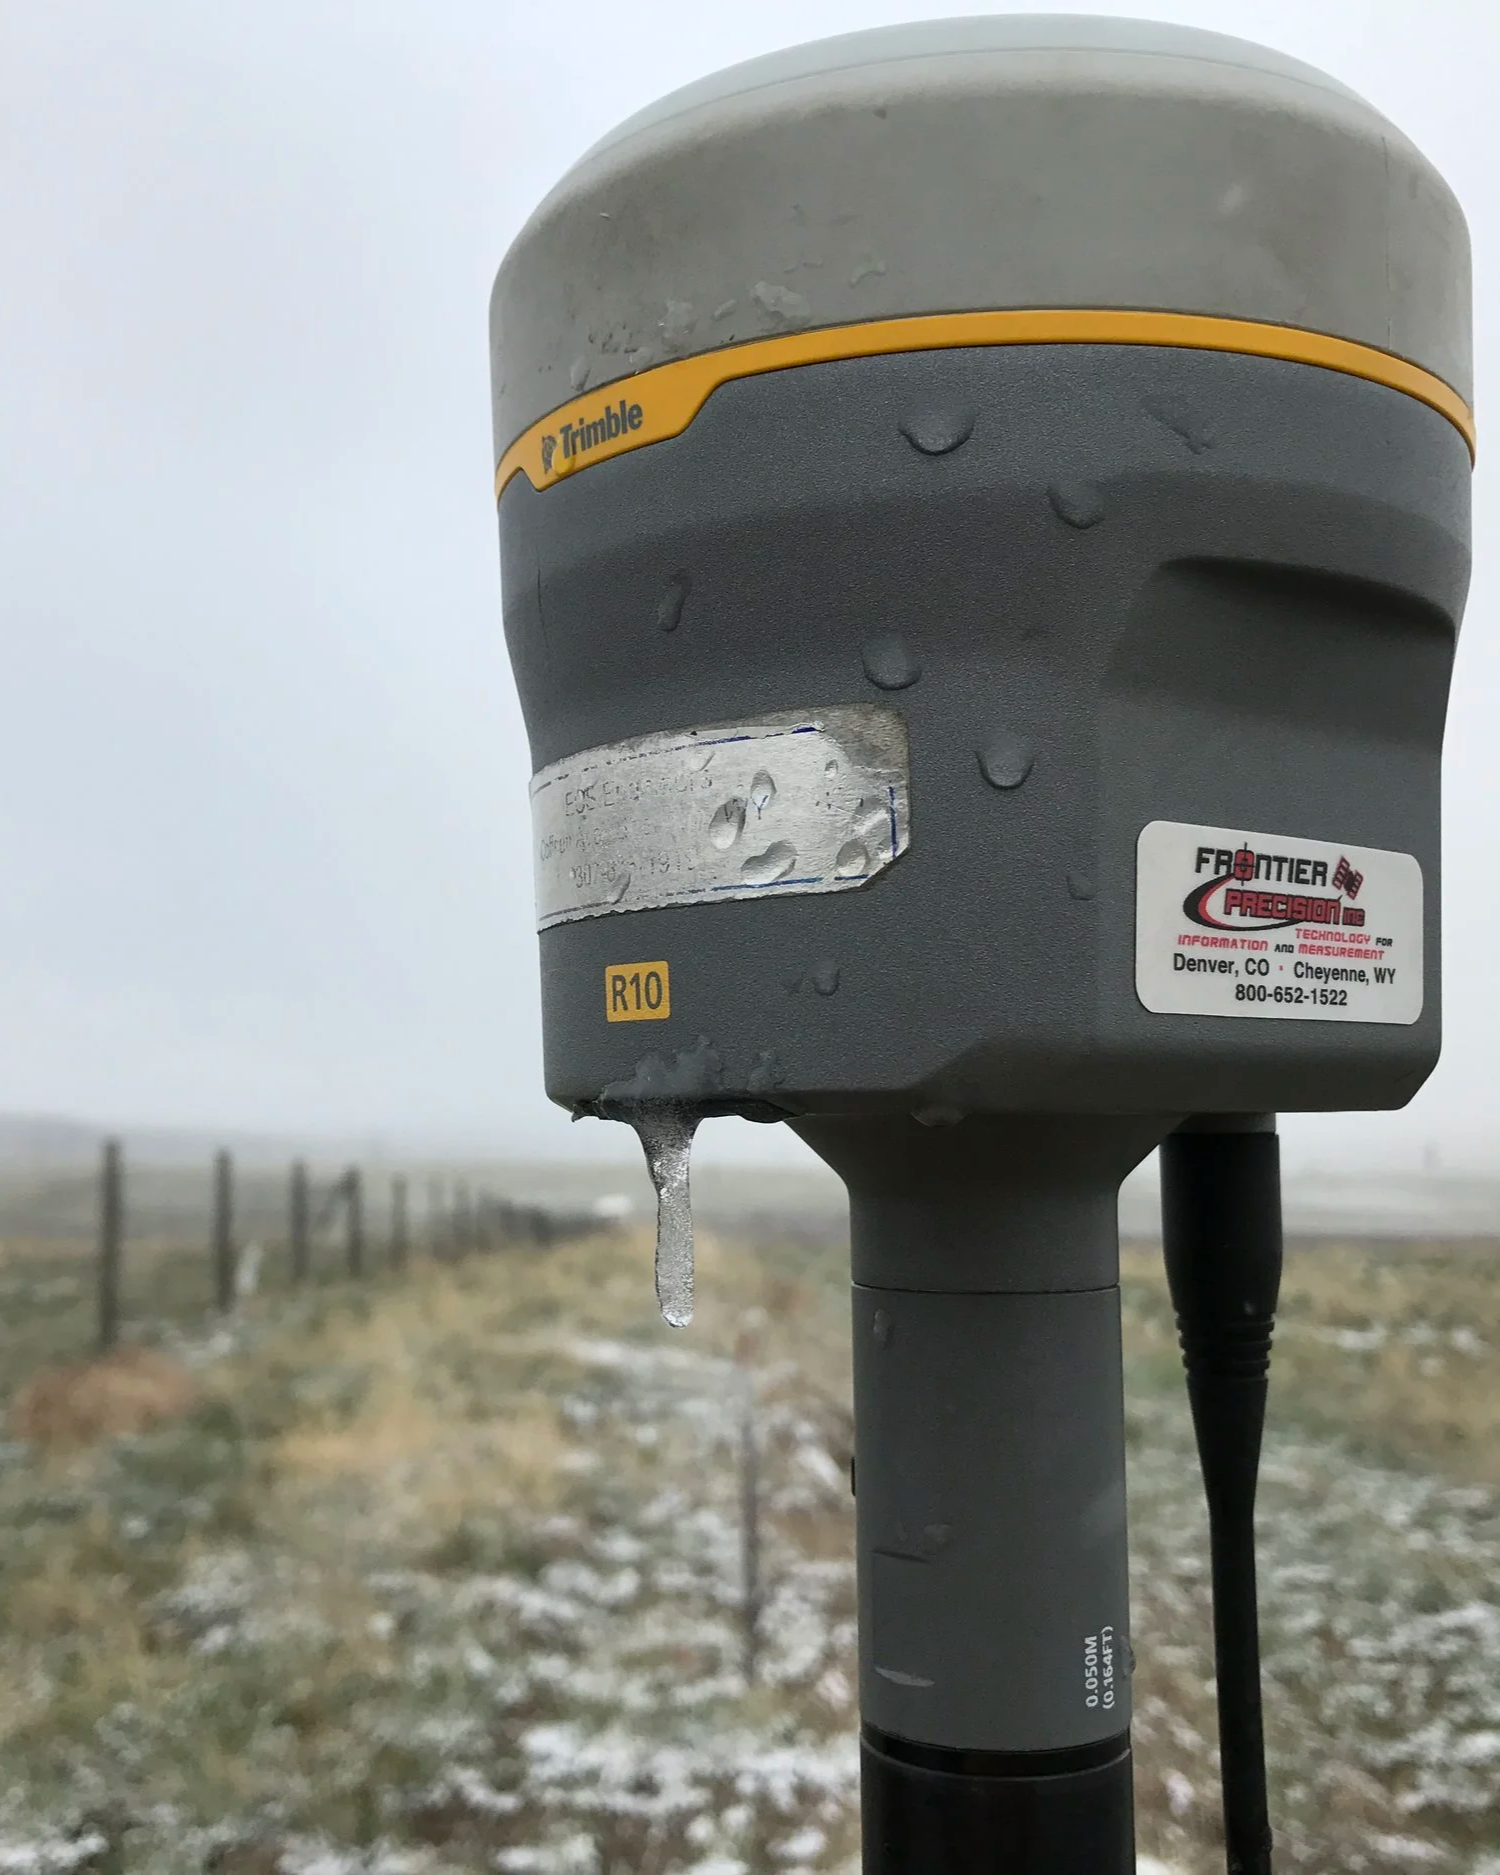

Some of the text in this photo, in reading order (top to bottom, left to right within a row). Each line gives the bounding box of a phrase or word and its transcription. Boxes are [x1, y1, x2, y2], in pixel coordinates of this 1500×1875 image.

[559, 400, 643, 459] Trimble
[1195, 846, 1328, 887] FRONTIER
[1223, 888, 1341, 926] PRECISION
[1178, 934, 1385, 960] INFORMATION AND MEASUREMENT
[1295, 928, 1393, 947] TECHNOLOGY FOR
[1173, 953, 1396, 985] Denver, CO Cheyenne, WY
[611, 971, 662, 1012] R10
[1235, 983, 1348, 1006] 800-652-1522
[1084, 1636, 1099, 1708] 0.050M
[1101, 1626, 1115, 1709] (0.164FT)
